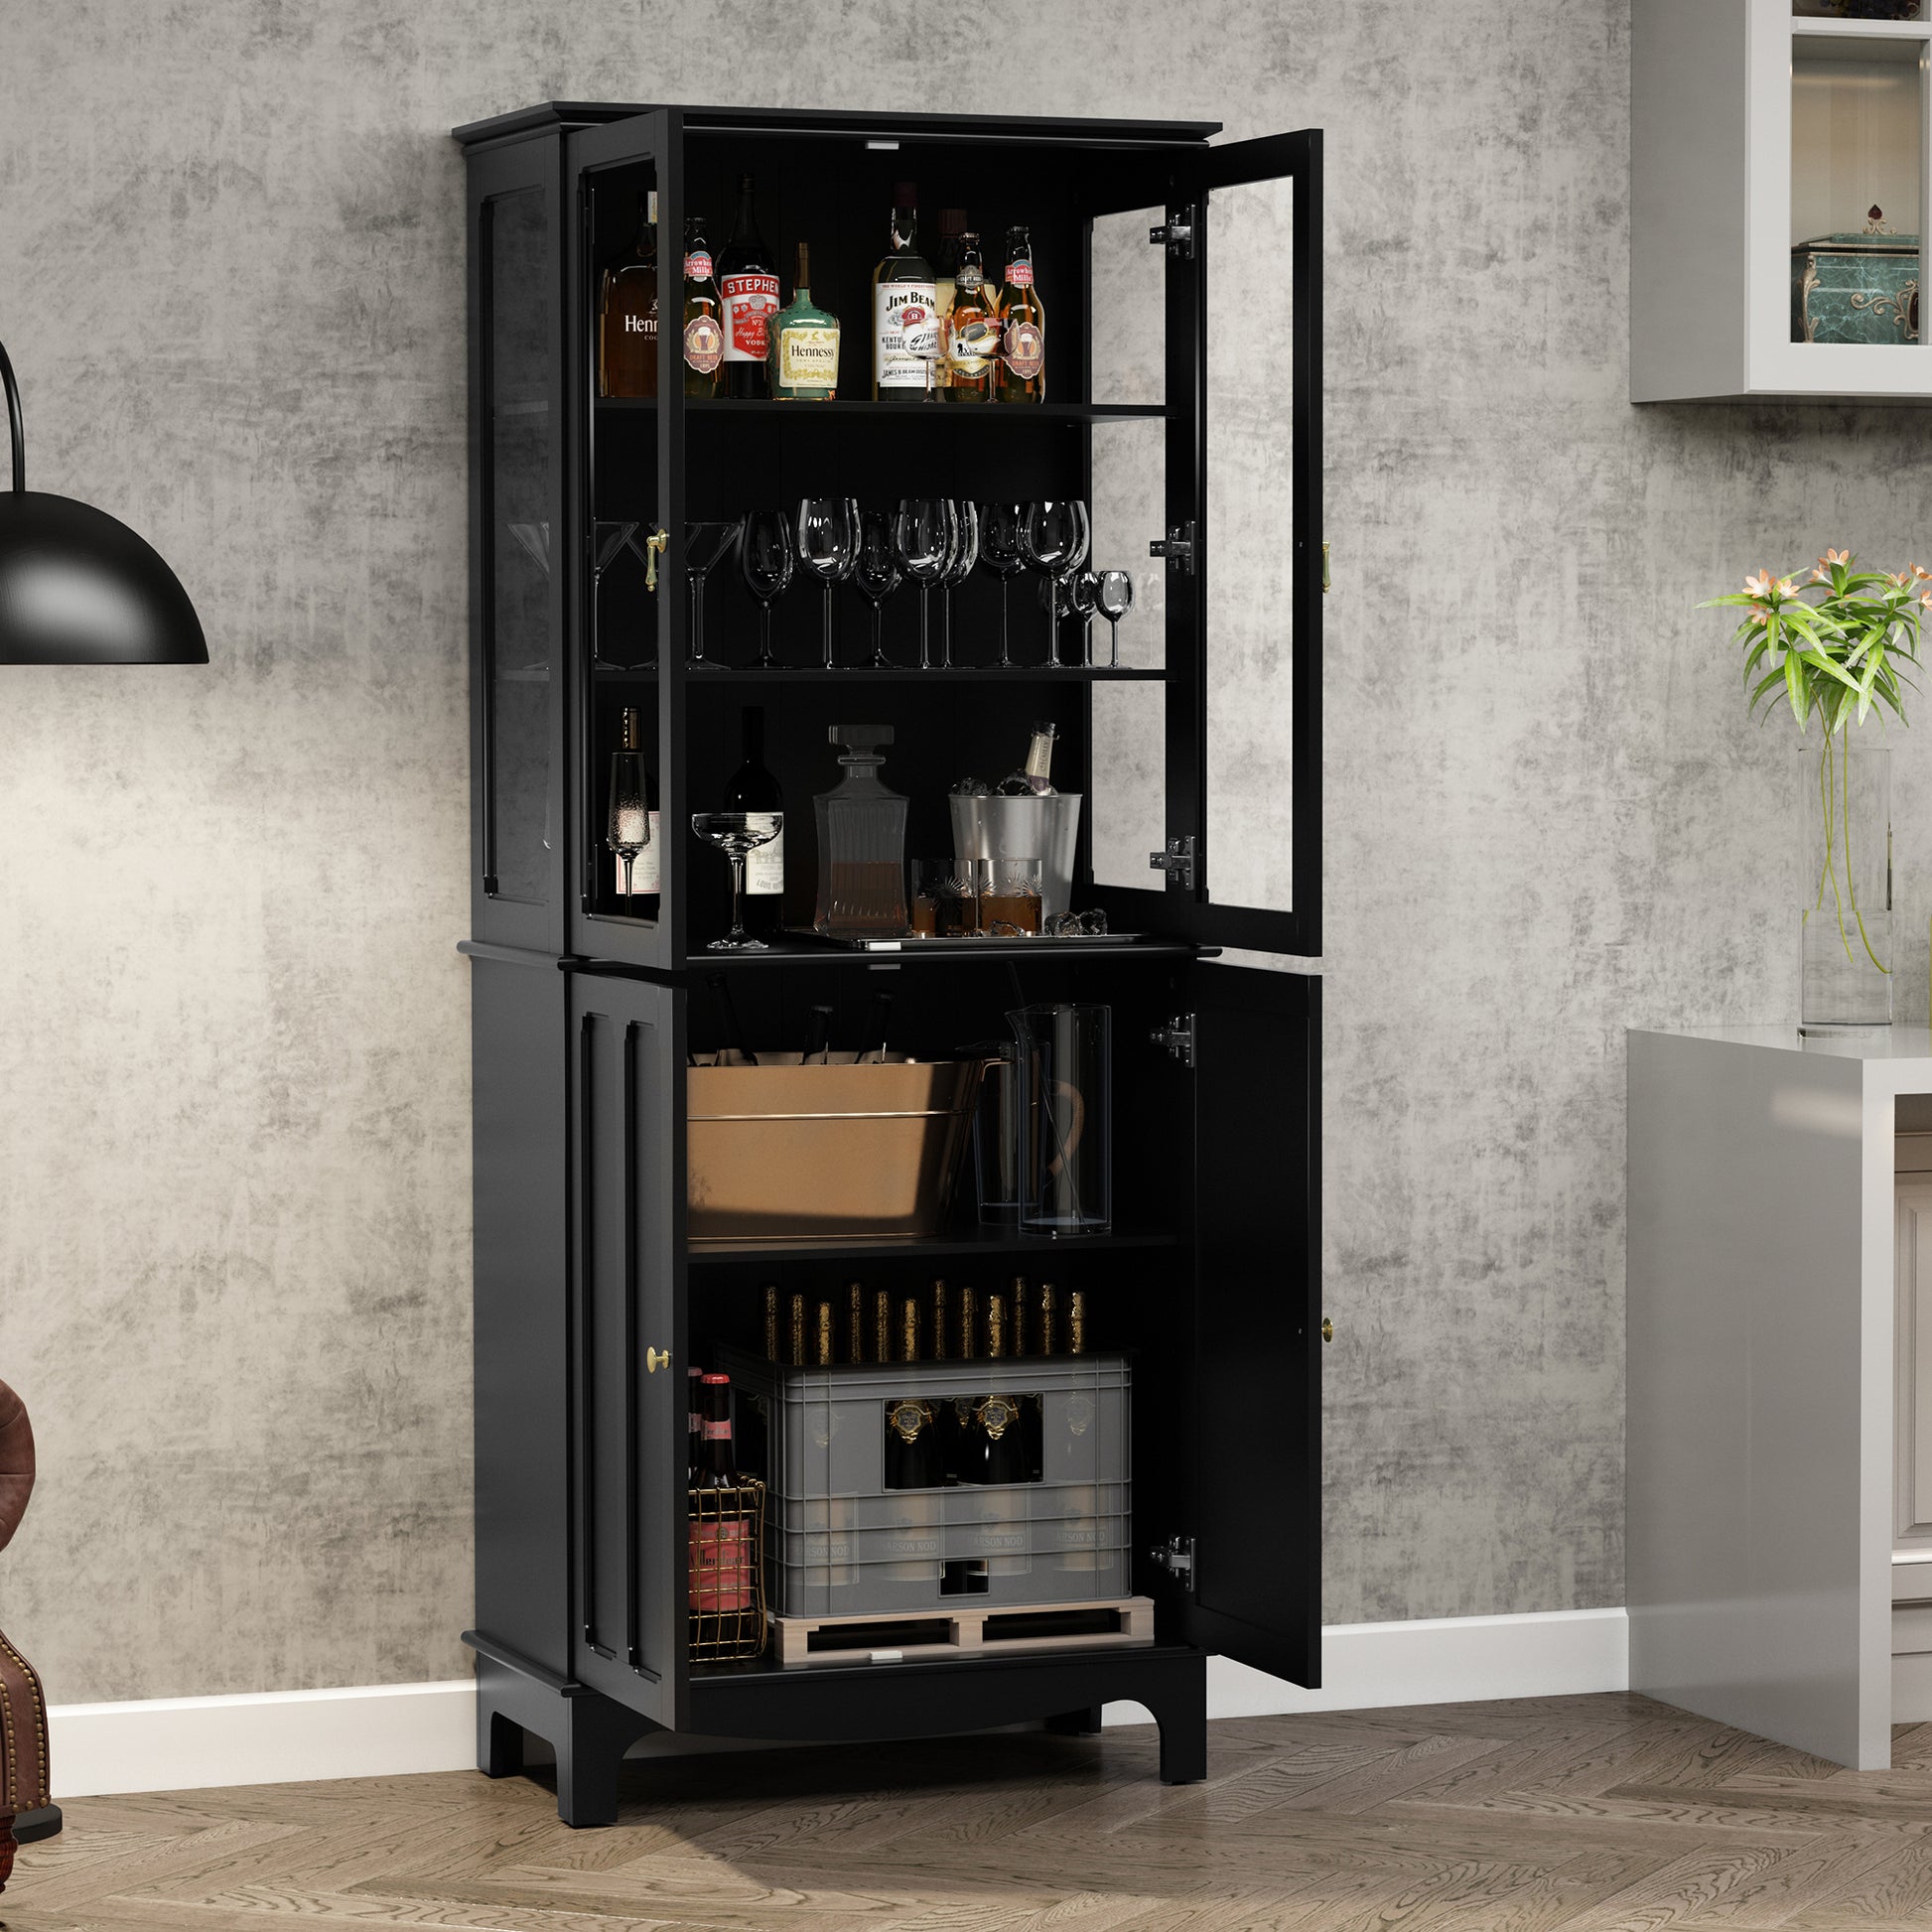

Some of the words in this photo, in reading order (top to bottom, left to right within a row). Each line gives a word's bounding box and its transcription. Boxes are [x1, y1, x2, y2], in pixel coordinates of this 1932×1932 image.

[886, 295, 907, 312] JIM
[791, 345, 835, 360] Hennessy
[918, 1540, 937, 1552] NOD
